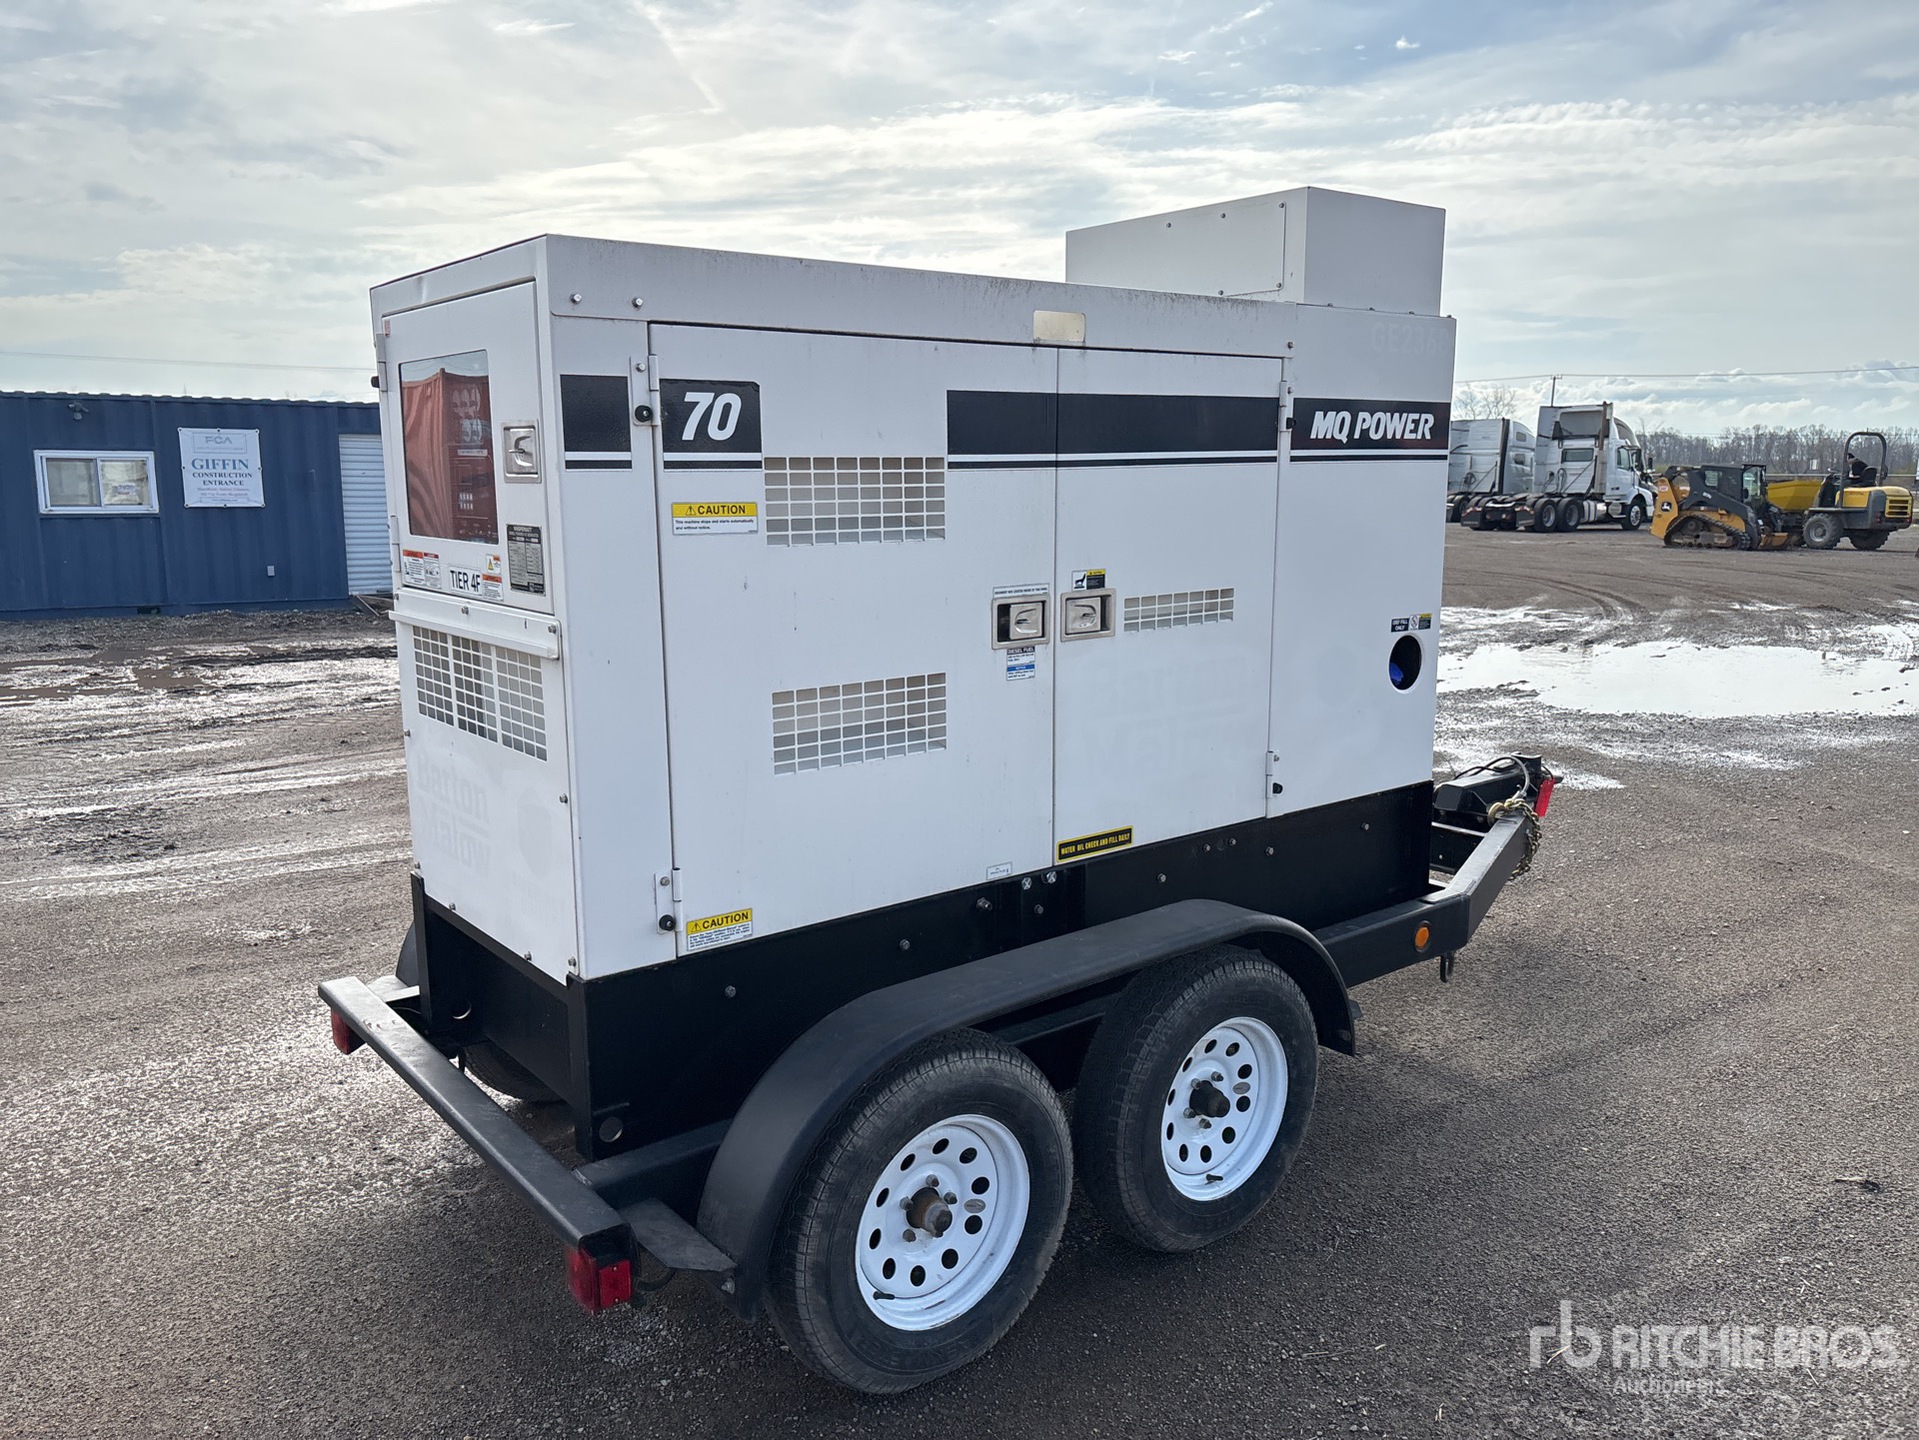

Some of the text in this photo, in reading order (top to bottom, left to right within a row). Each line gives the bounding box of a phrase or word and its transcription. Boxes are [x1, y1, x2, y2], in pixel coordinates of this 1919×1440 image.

[681, 391, 742, 441] 70
[1310, 410, 1435, 444] MQ POWER
[205, 436, 232, 445] FCA
[191, 458, 249, 470] GIFFIN
[697, 505, 746, 515] CAUTION
[450, 570, 469, 591] TIER
[471, 573, 481, 592] 4F
[1085, 840, 1099, 849] CHECK
[1099, 837, 1108, 846] AND
[1108, 835, 1118, 844] FILL
[702, 911, 749, 930] CAUTION
